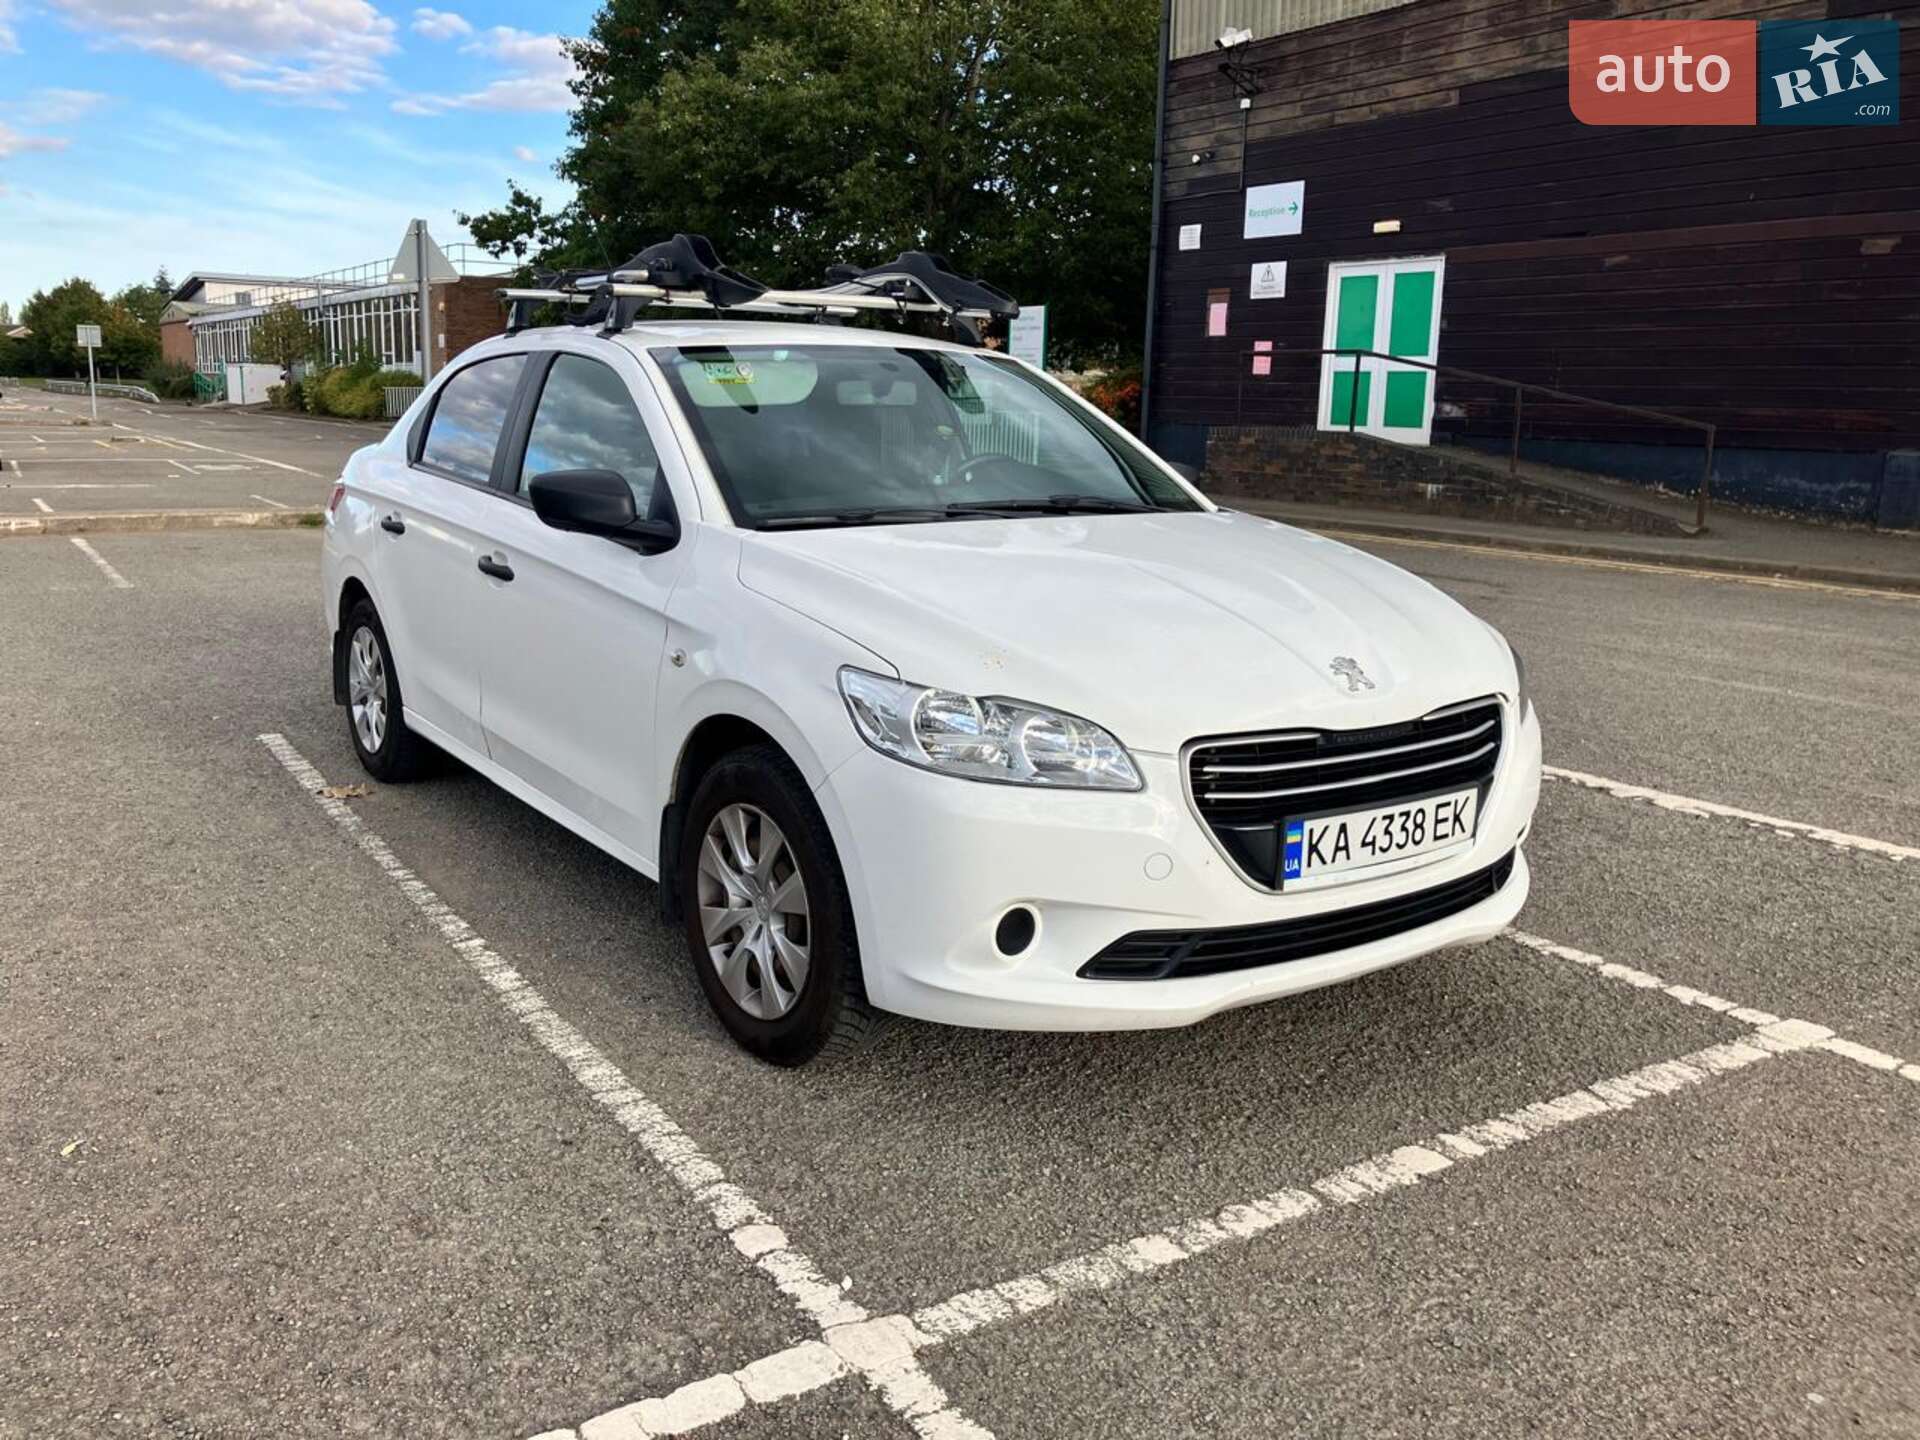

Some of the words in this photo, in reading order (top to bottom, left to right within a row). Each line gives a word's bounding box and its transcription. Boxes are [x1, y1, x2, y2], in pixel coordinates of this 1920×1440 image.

[1248, 206, 1286, 219] Reception
[1306, 821, 1351, 868] KA
[1360, 808, 1426, 856] 4338
[1432, 796, 1470, 842] EK
[1284, 858, 1299, 872] UA
